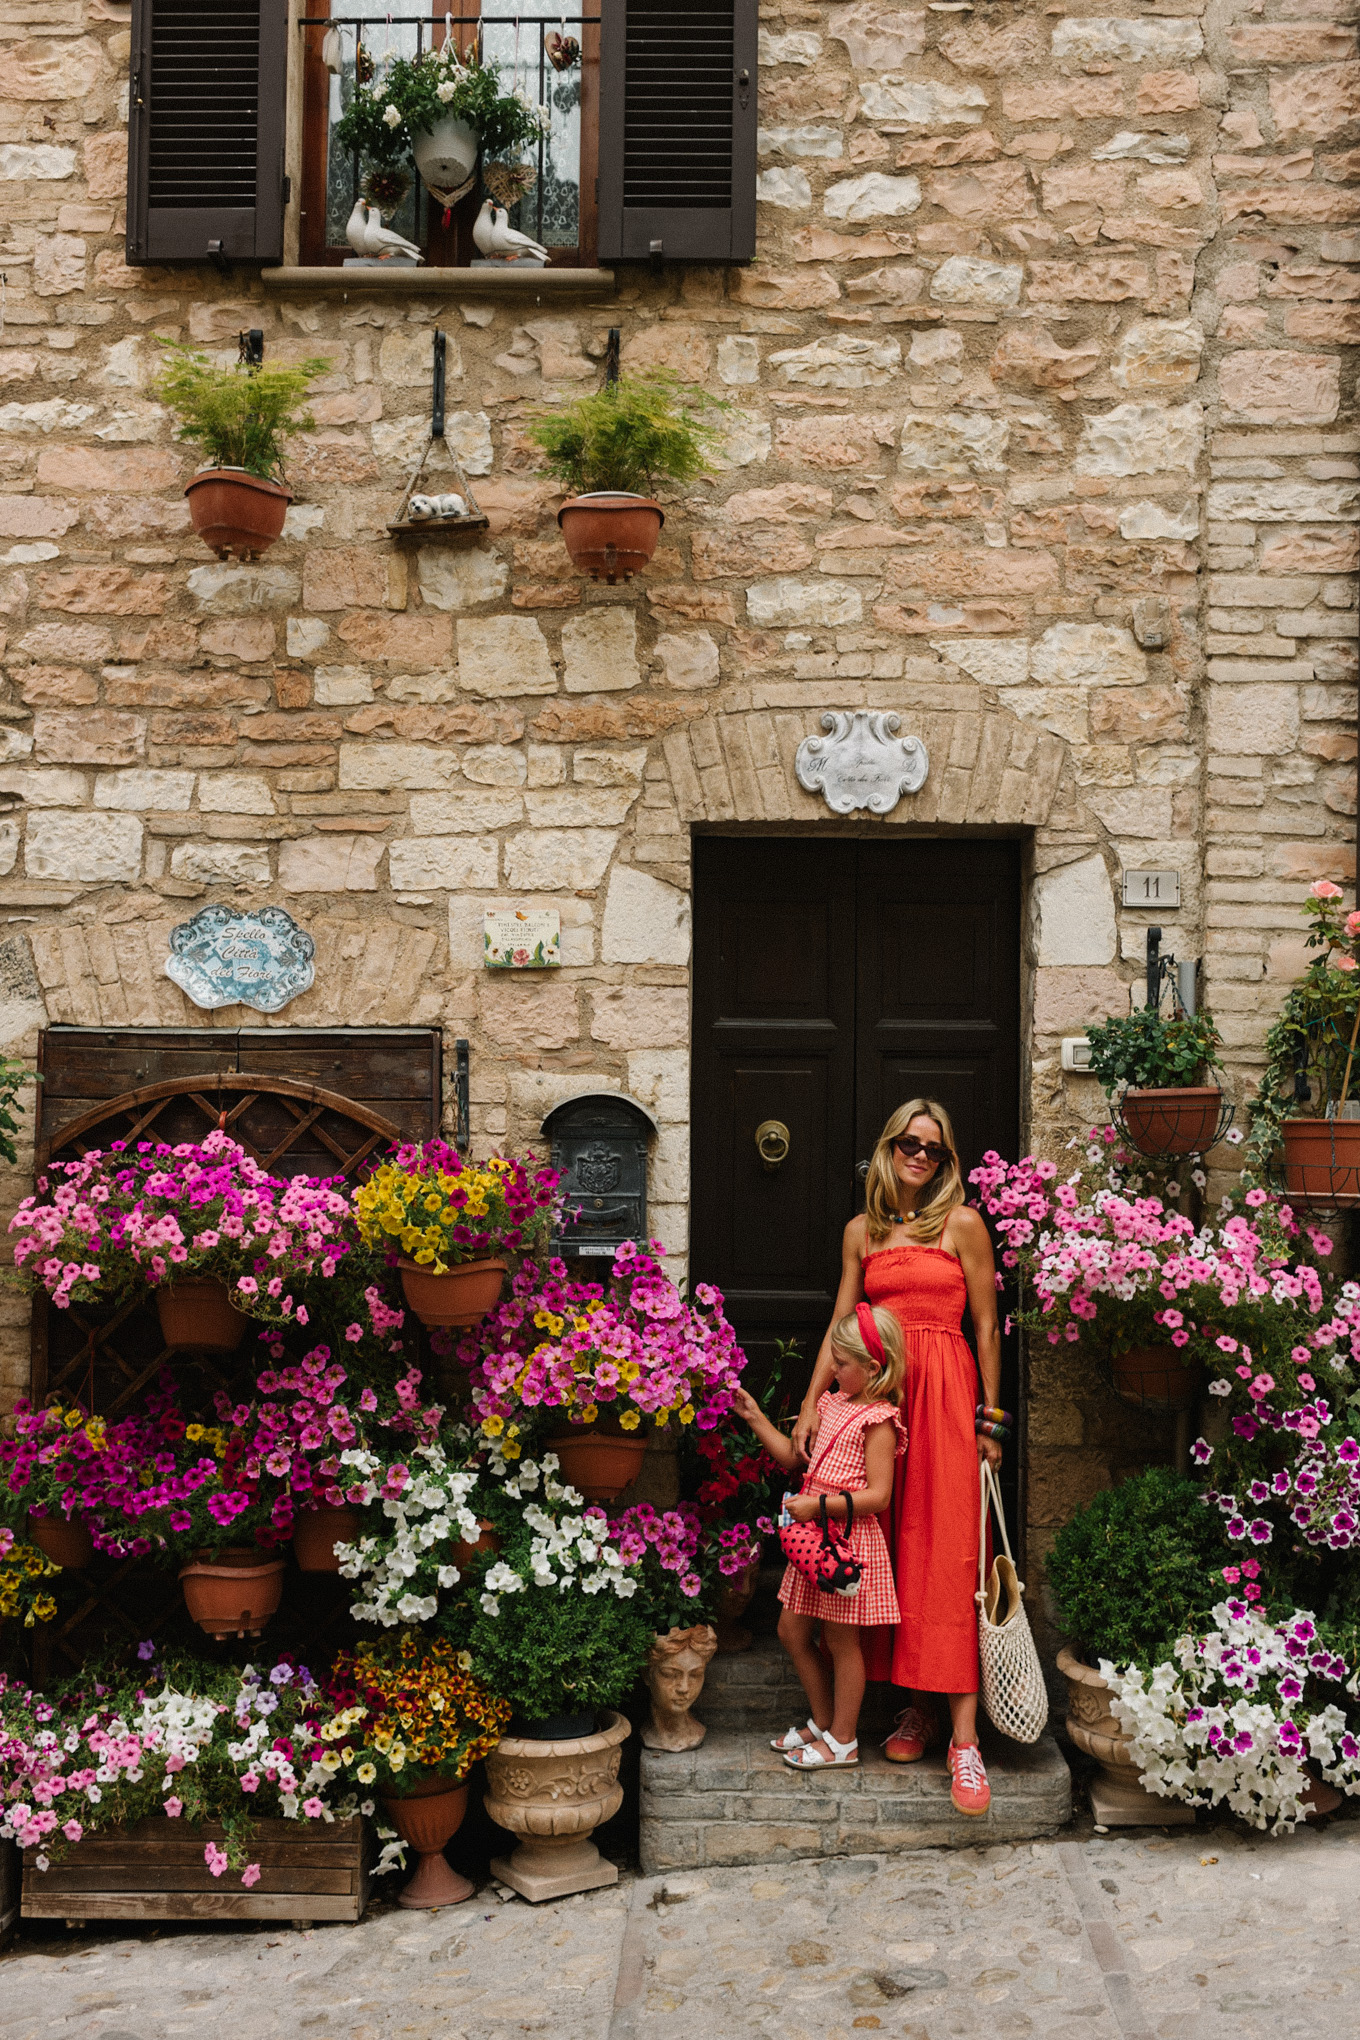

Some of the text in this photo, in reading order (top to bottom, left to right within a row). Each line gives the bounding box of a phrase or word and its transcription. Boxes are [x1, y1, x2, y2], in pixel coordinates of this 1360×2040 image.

[807, 757, 829, 772] M
[1143, 876, 1161, 898] 11
[222, 927, 266, 941] Spello
[222, 946, 258, 960] Città
[211, 966, 273, 980] dei Fiori
